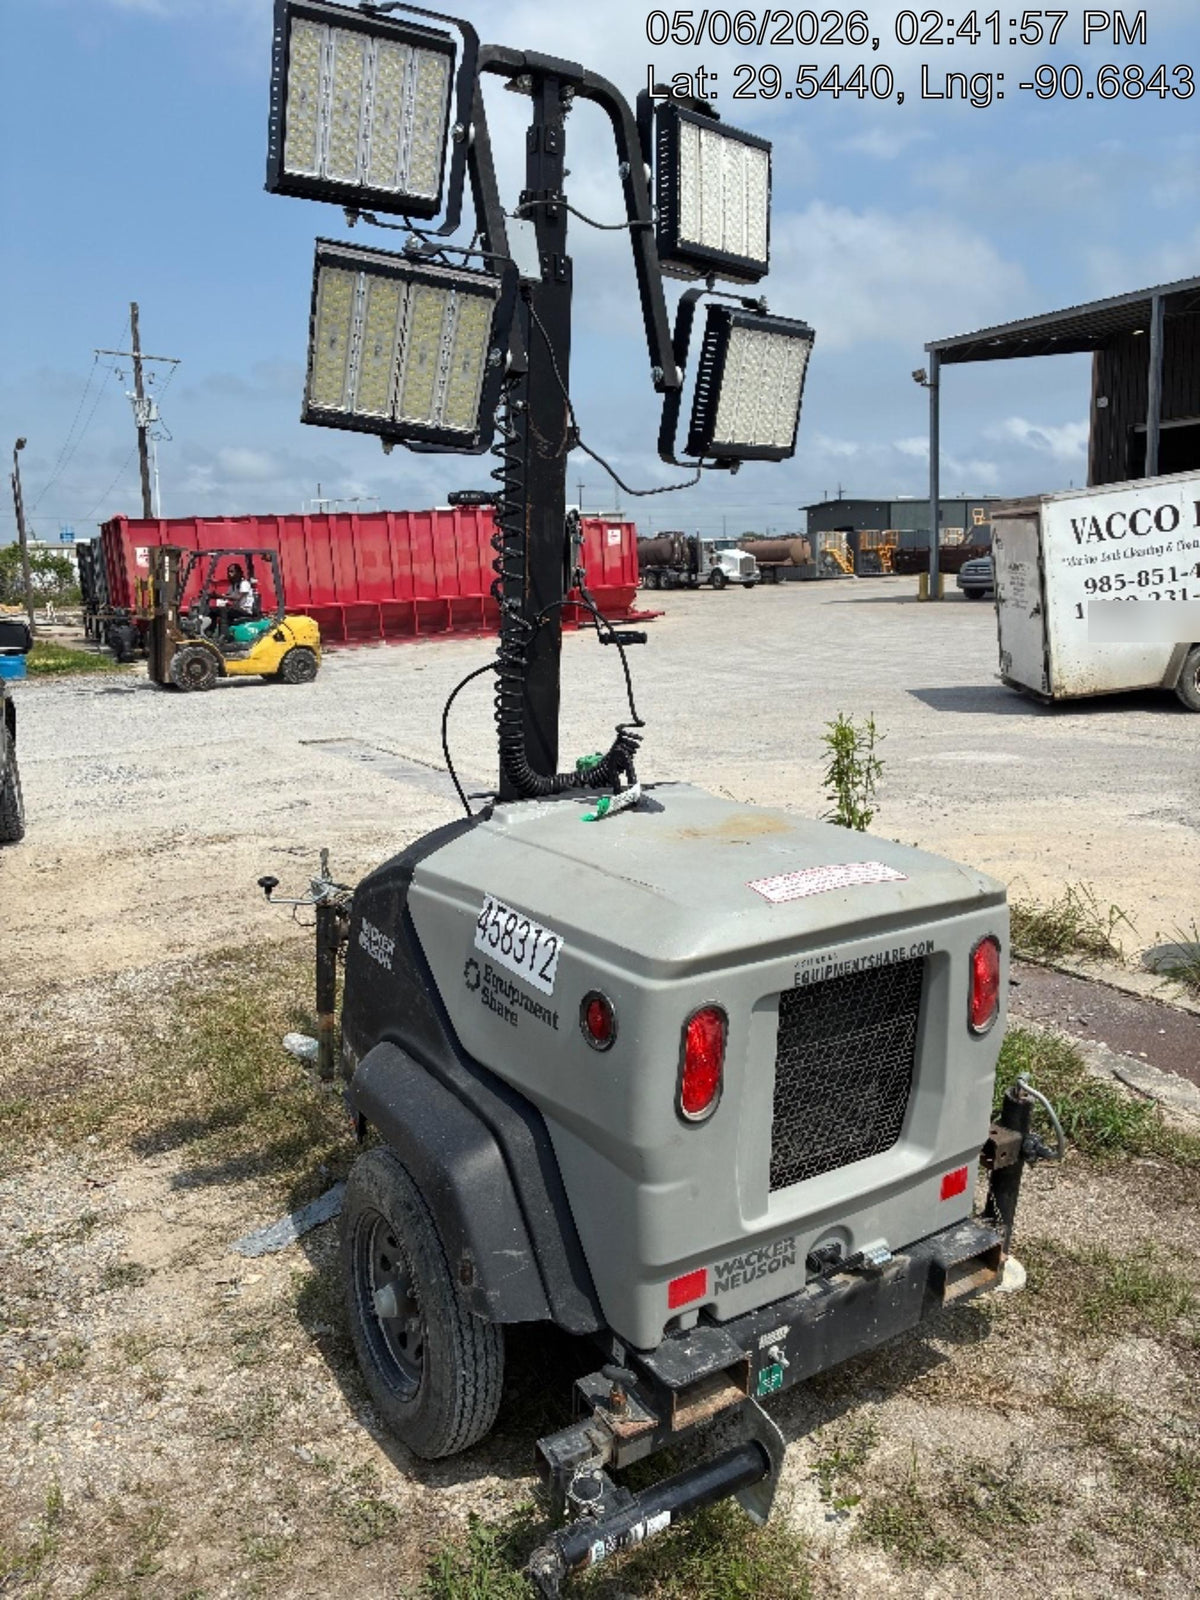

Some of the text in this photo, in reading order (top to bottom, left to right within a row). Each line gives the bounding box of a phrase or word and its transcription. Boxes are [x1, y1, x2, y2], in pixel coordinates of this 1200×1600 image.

[1070, 504, 1180, 544] VACCO
[478, 901, 557, 983] 458312
[794, 940, 935, 987] EQUIPMENTSHARE.COM
[481, 986, 518, 1026] Share
[484, 964, 559, 1030] Equipment
[714, 1237, 797, 1279] WACKER
[714, 1252, 796, 1296] NEUSON
